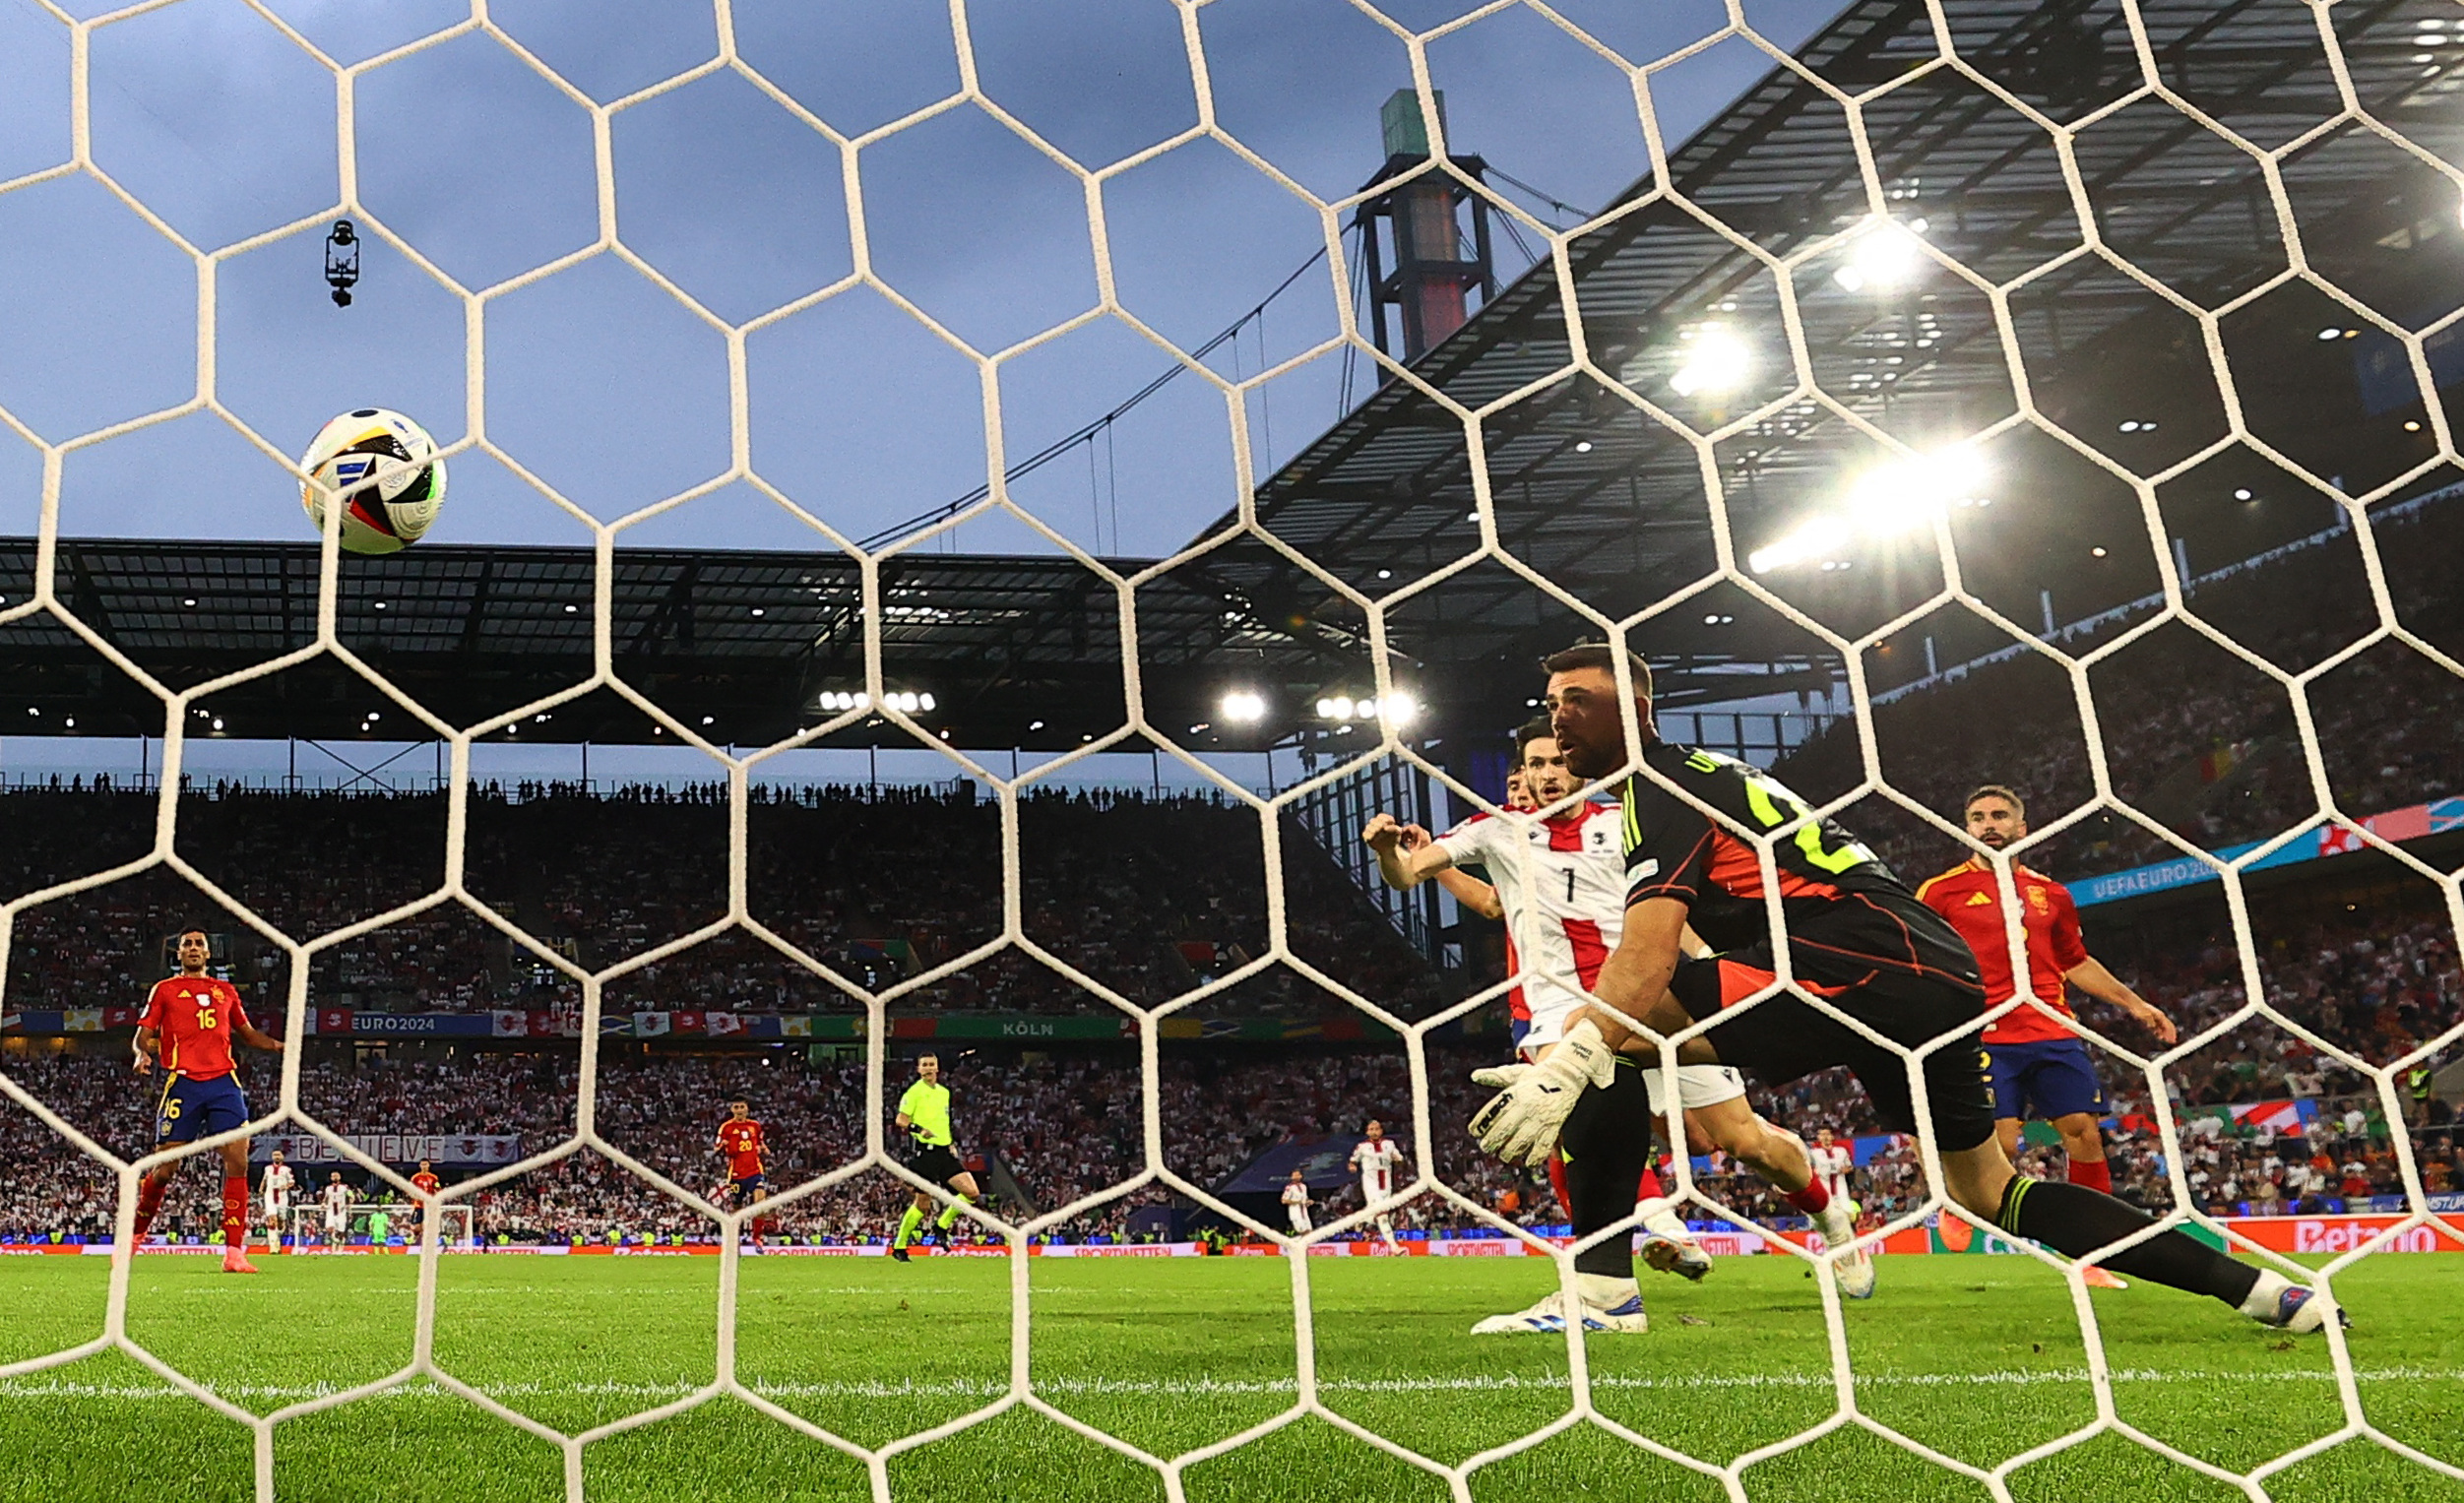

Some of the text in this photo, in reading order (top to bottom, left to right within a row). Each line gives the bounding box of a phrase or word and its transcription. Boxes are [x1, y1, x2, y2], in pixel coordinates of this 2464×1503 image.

[1561, 867, 1575, 904] 7
[196, 1008, 218, 1030] 16
[1003, 1020, 1054, 1035] KÖLN
[162, 1097, 182, 1119] 16
[1477, 1093, 1514, 1135] reusch
[297, 1137, 443, 1162] BEIEVE
[738, 1140, 752, 1153] 20
